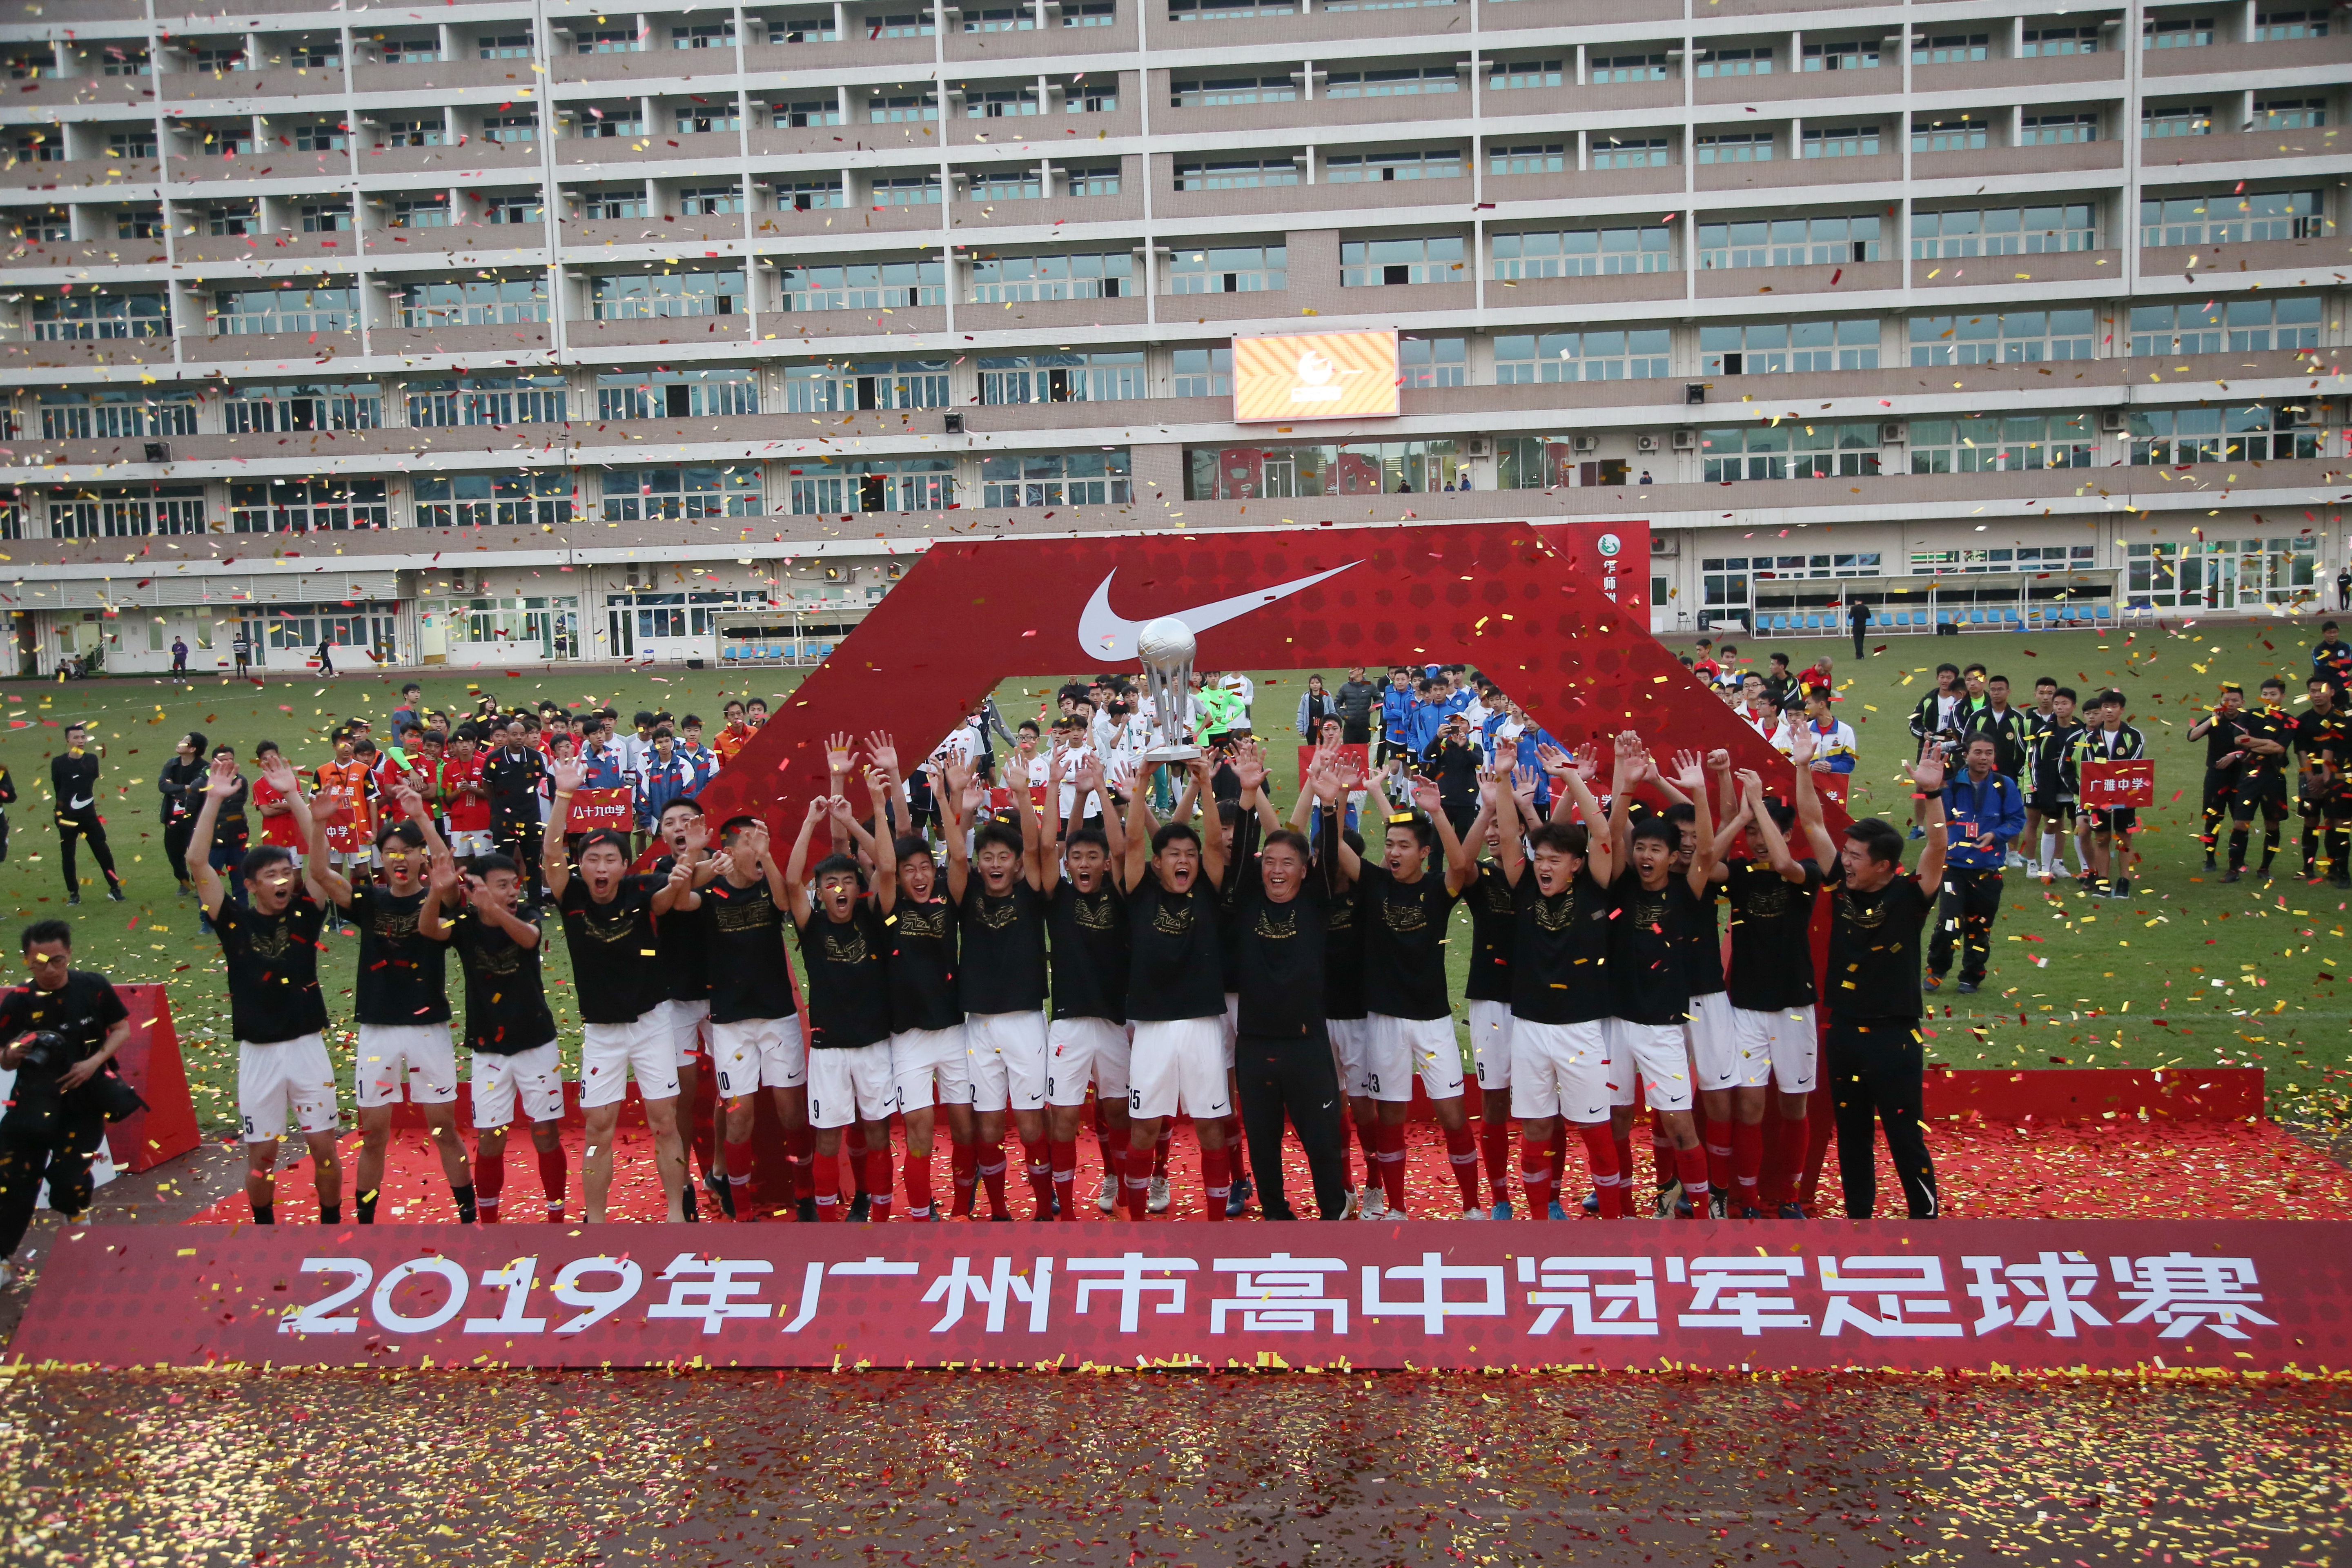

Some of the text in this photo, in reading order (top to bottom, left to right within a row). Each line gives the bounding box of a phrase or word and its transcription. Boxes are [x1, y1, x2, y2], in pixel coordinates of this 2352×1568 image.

[2090, 778, 2143, 792] 广雅中学
[573, 804, 626, 817] 八十九中学
[718, 1071, 731, 1091] 10
[1368, 1071, 1380, 1093] 23
[814, 1099, 820, 1119] 9
[1130, 1088, 1140, 1110] 15
[278, 1251, 2279, 1339] 2019年广州市高中冠军足球赛
